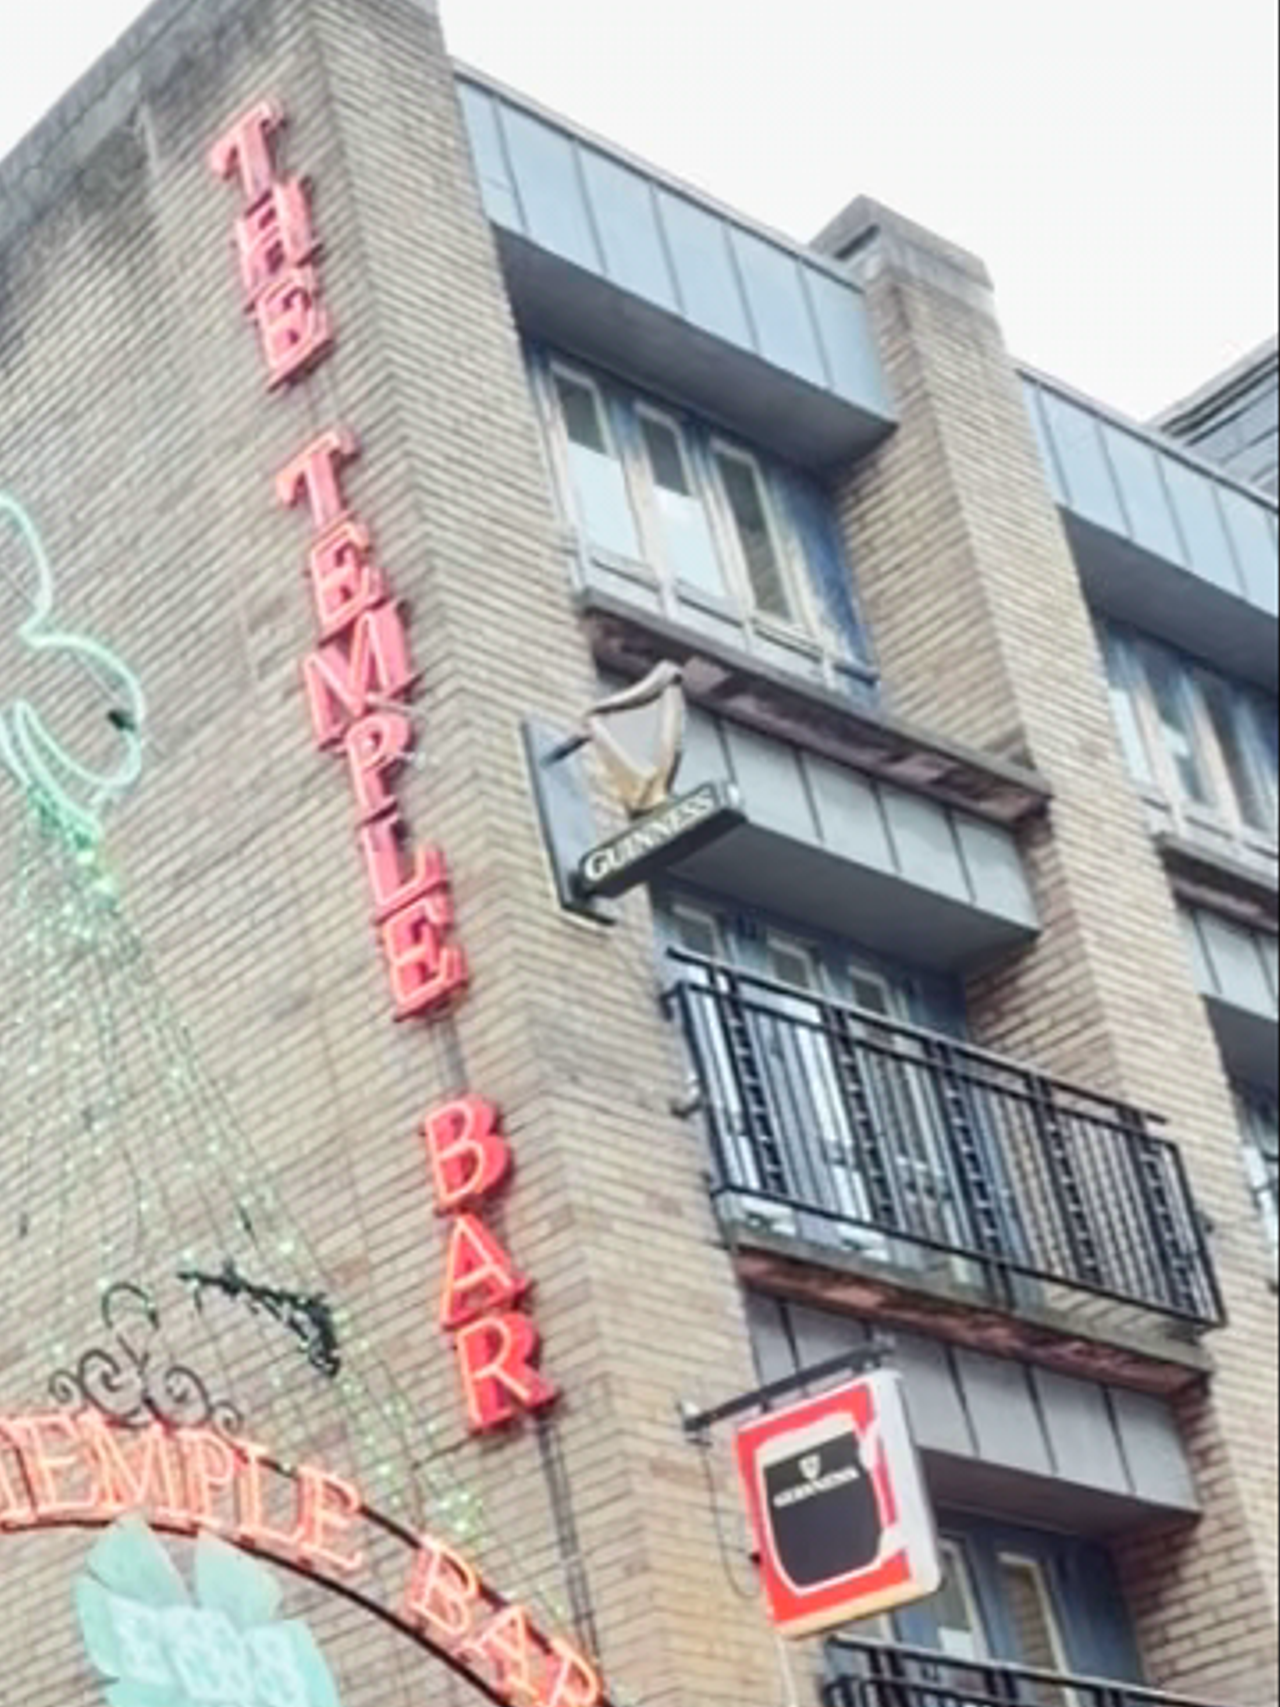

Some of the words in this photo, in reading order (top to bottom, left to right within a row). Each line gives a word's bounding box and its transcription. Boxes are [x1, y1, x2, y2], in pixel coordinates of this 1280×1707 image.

[208, 98, 331, 391] THE
[276, 426, 468, 1020] TEMPLE
[424, 1095, 558, 1436] BAR
[583, 791, 714, 881] GUINNESS
